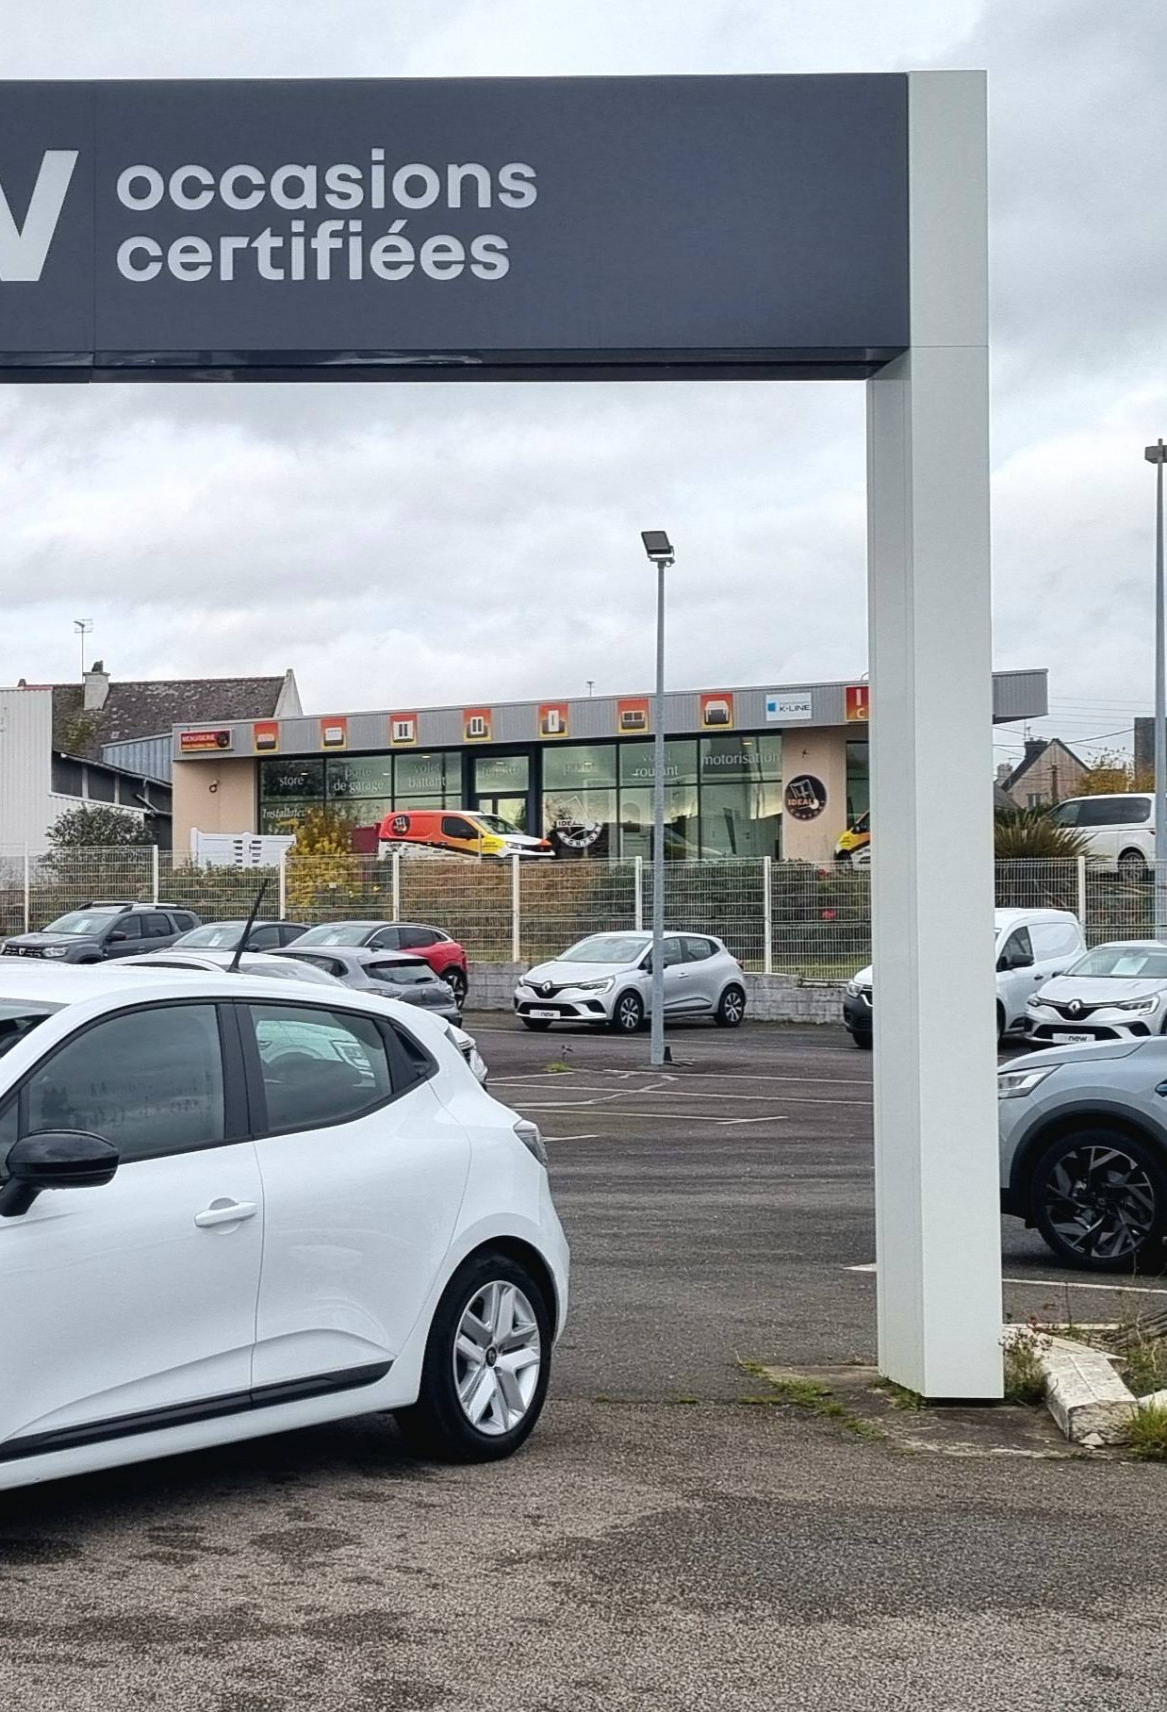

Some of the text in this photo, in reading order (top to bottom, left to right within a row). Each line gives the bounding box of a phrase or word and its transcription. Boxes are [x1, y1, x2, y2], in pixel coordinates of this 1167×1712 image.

[116, 148, 537, 210] occasions
[116, 219, 510, 281] certifiées
[702, 751, 780, 766] motorisation
[635, 765, 678, 777] rouant
[279, 775, 305, 787] store
[333, 779, 384, 793] de garage
[408, 776, 446, 788] battant
